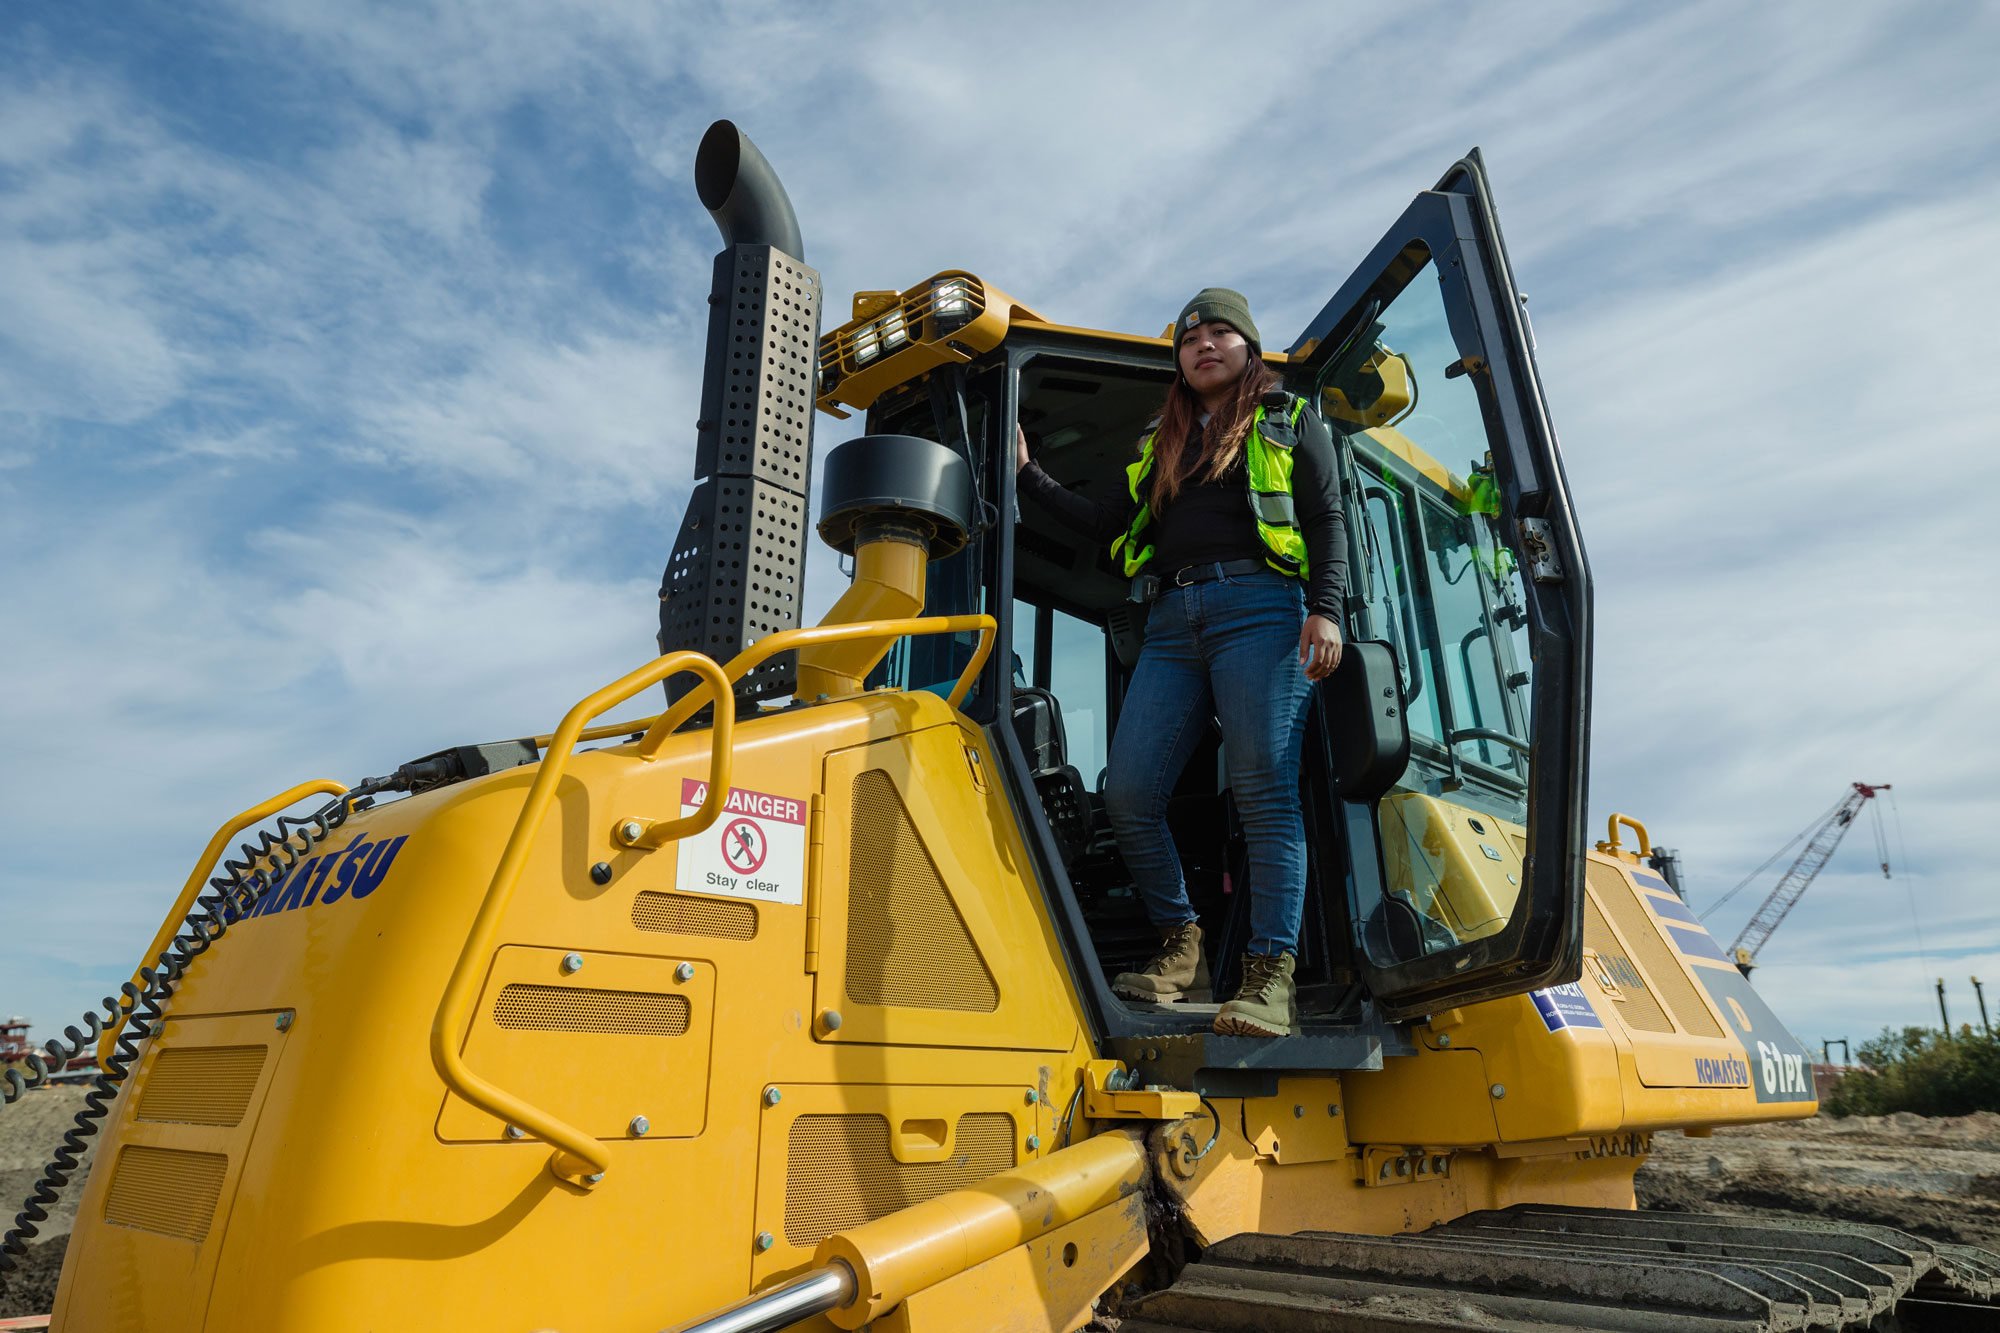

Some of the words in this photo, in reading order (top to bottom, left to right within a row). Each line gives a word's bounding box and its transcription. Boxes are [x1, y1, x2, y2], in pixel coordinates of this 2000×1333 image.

[723, 792, 799, 821] ANGER
[203, 831, 410, 927] MATSU
[706, 872, 738, 890] Stay
[746, 878, 780, 893] clear
[1726, 996, 1753, 1032] D
[1694, 1053, 1748, 1085] KOMATSU
